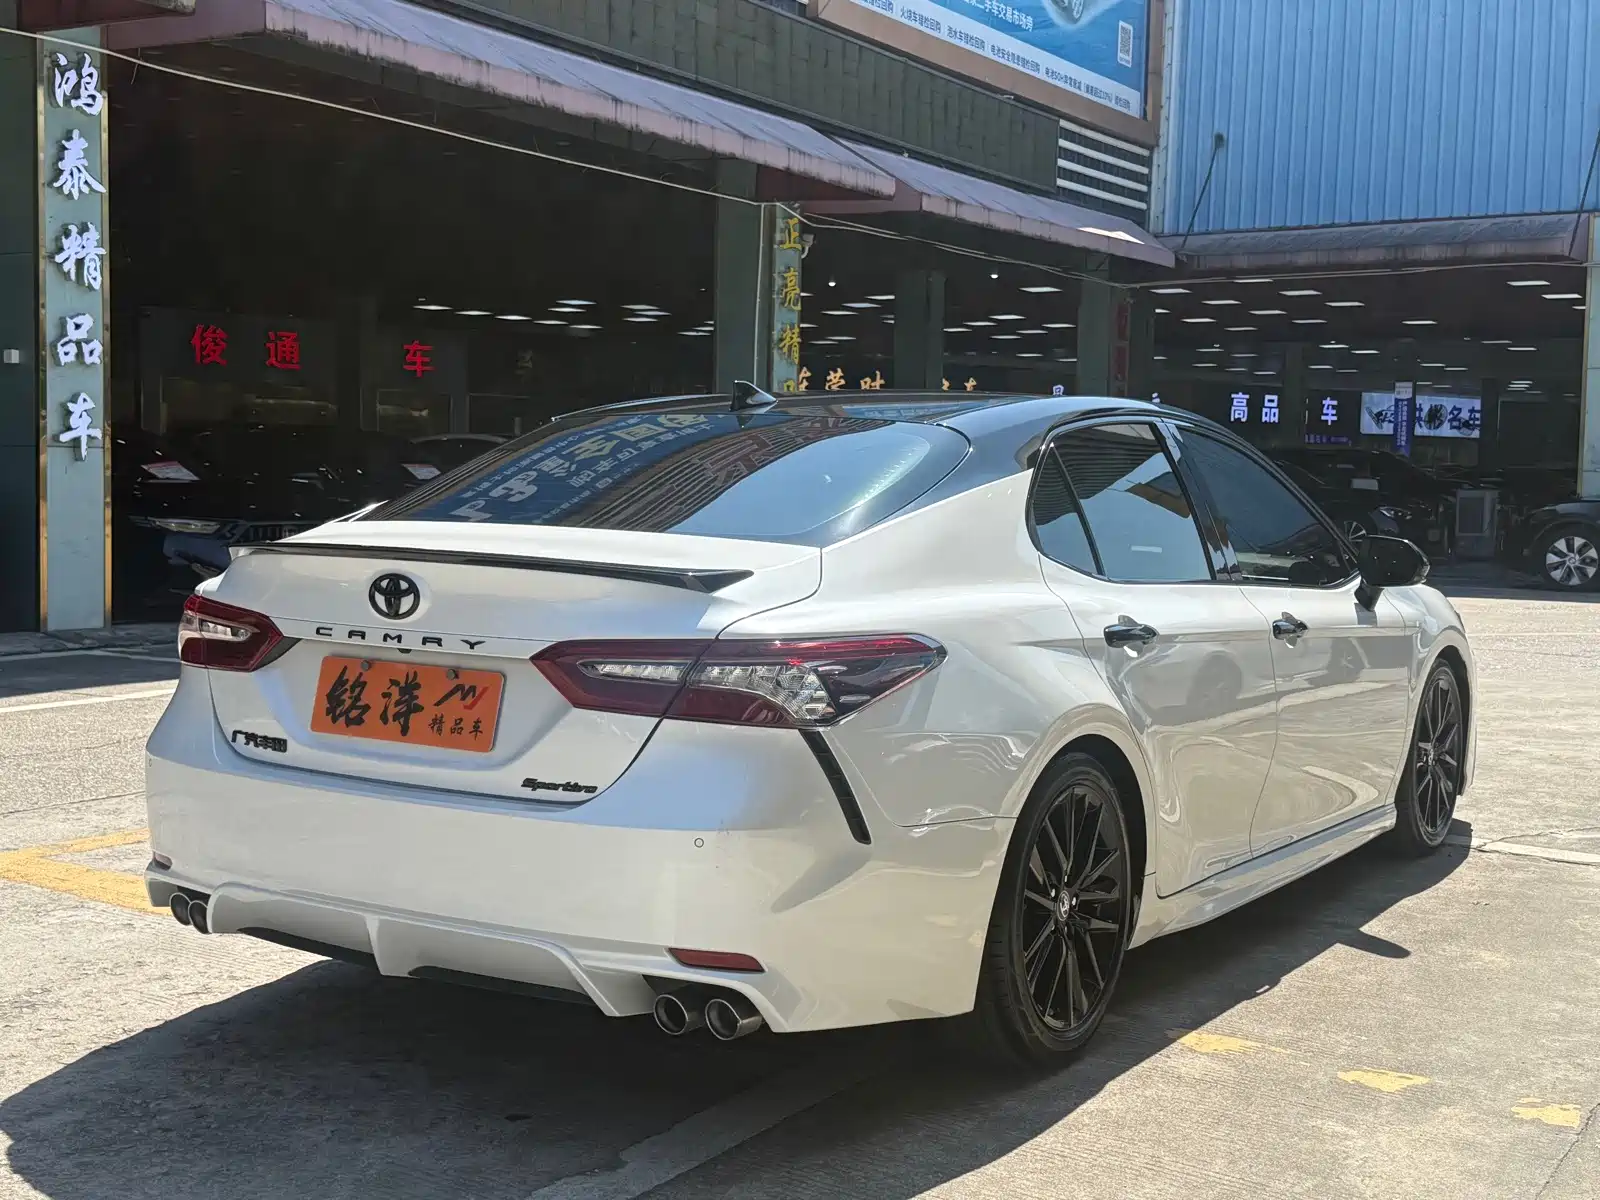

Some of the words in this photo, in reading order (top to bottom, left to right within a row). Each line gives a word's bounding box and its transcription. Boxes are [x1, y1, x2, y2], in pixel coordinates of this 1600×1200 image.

[53, 52, 107, 461] 鸿泰精品车
[315, 626, 486, 650] CAMRY
[428, 713, 484, 741] 精品车
